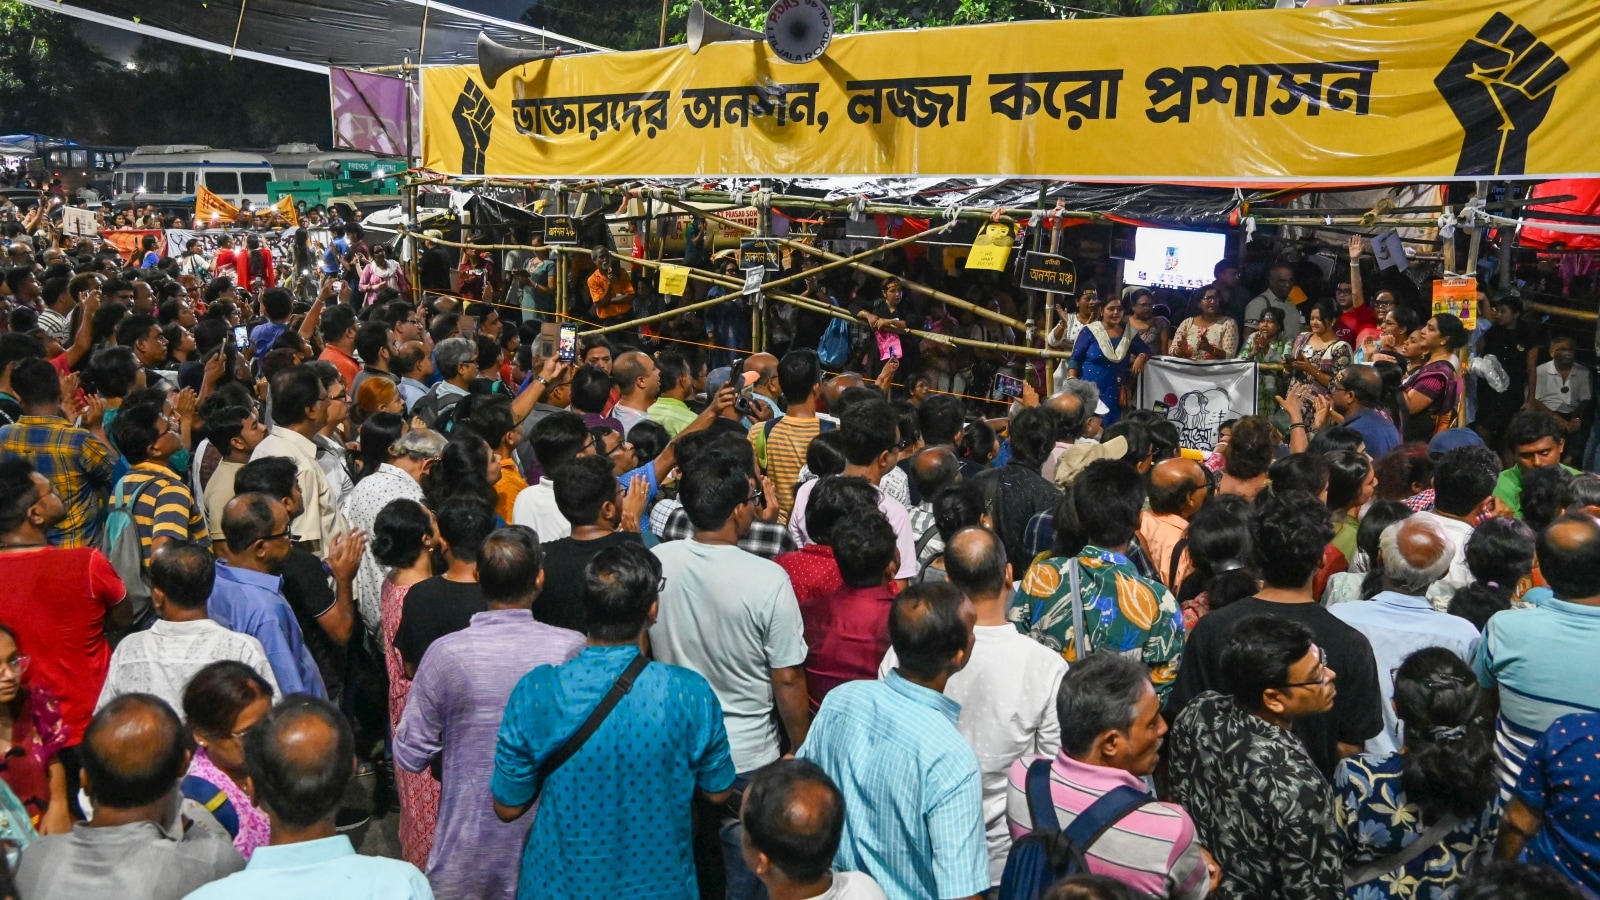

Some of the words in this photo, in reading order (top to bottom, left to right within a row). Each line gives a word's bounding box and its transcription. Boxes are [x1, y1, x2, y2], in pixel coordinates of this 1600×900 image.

[769, 35, 803, 61] TILJALA
[511, 90, 670, 141] ডাক্তারদের
[681, 83, 829, 134] অনশন,
[846, 75, 972, 128] লজ্জা
[988, 69, 1124, 131] করো
[1144, 60, 1380, 123] প্রশাসন
[725, 210, 745, 218] PRASAD
[1030, 268, 1058, 283] অনশন
[1059, 272, 1073, 285] মঞ্চ
